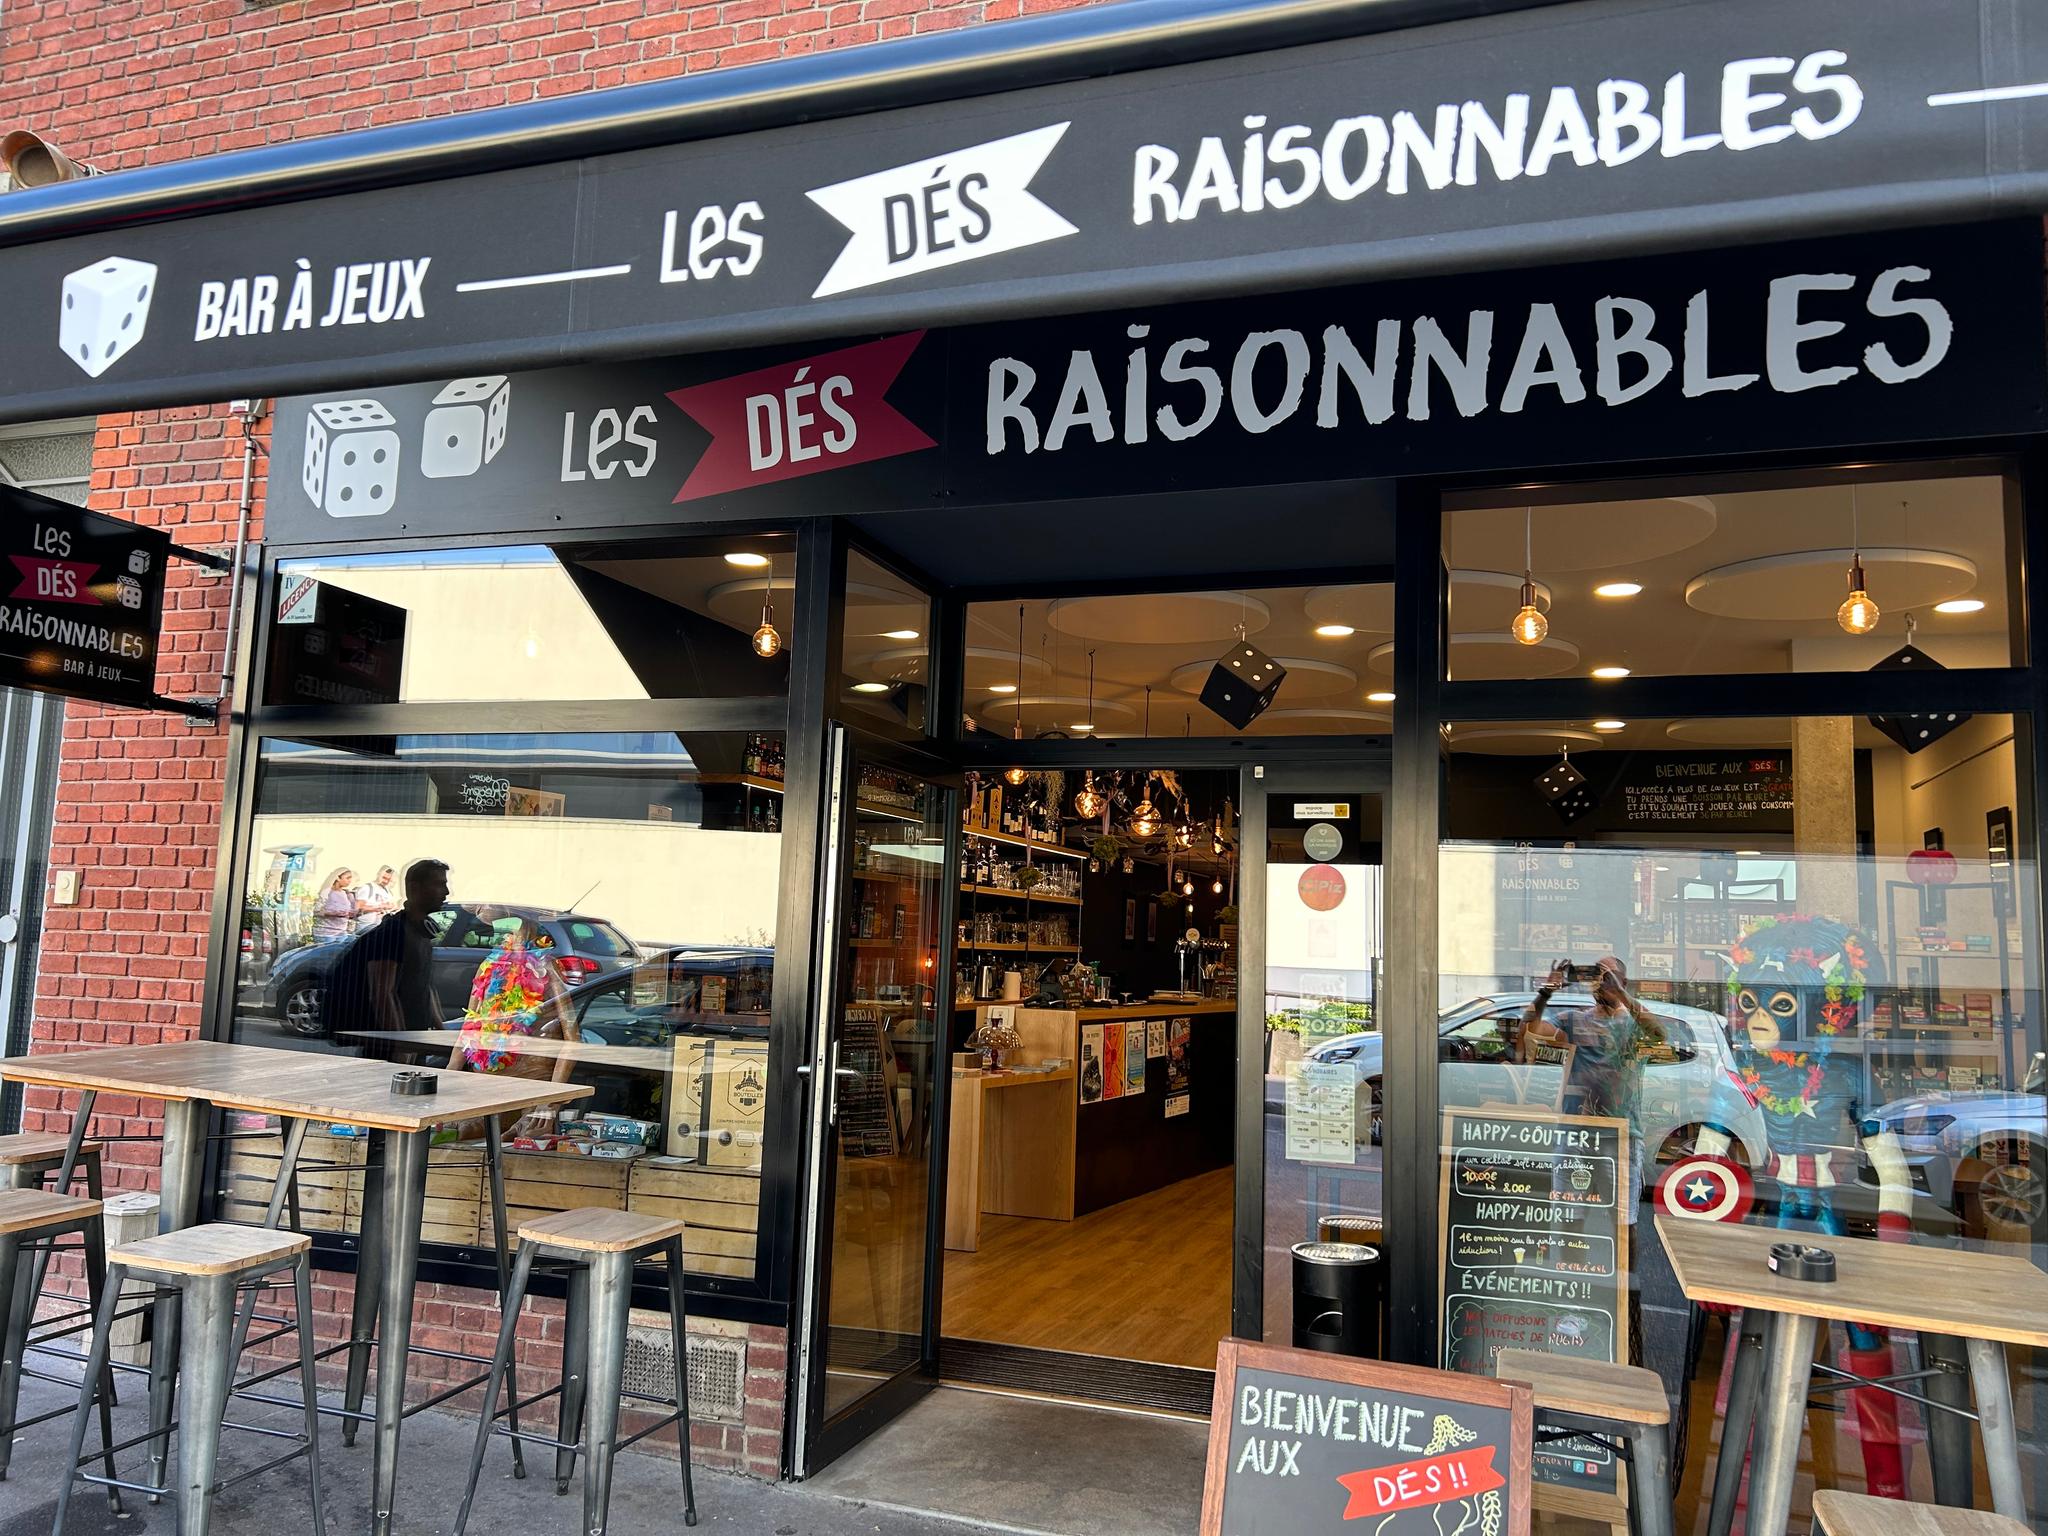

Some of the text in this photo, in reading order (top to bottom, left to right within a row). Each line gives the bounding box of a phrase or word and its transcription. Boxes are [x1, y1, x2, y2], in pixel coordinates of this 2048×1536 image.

[194, 279, 278, 343] BAR
[282, 257, 313, 332] À
[320, 256, 433, 329] JEUX
[882, 164, 993, 266] DÉS
[744, 366, 859, 472] DÉS
[37, 562, 77, 598] DÉS
[63, 658, 122, 683] BAR À JEUX
[1656, 763, 1717, 778] BIENVENUE
[1721, 761, 1743, 774] AUX
[1677, 784, 1693, 793] PLUS
[1697, 784, 1707, 793] DE
[1723, 784, 1740, 792] JEUX
[1744, 783, 1759, 791] EST
[1626, 796, 1636, 804] TU
[1641, 795, 1669, 804] PRENDS
[1672, 795, 1687, 803] UNE
[1660, 803, 1704, 811] SOUHAITES
[1708, 803, 1734, 811] JOUER
[1737, 802, 1757, 810] SANS
[1651, 811, 1696, 819] SEULEMENT
[1480, 1153, 1512, 1165] cocktail
[1503, 1182, 1531, 1193] 8,00€
[1484, 1234, 1509, 1242] moins
[1492, 1312, 1547, 1326] DIFFUSONS
[1530, 1333, 1544, 1343] DE
[1240, 1384, 1425, 1453] BIENVENUE
[1235, 1436, 1302, 1478] AUX
